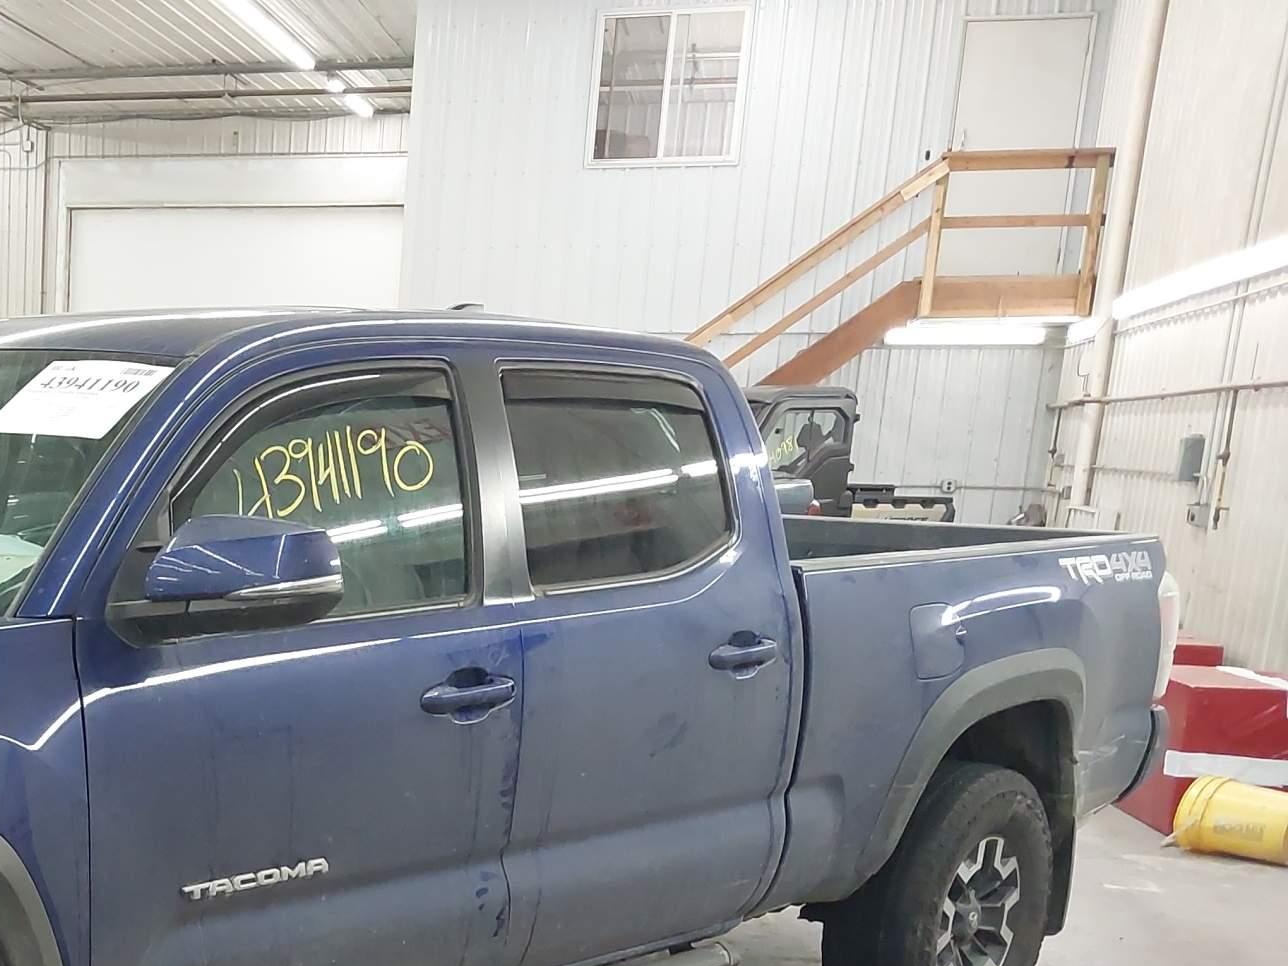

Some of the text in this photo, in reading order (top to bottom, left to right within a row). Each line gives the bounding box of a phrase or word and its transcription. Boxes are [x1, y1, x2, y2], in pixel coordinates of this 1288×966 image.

[40, 371, 141, 394] 43941190
[1058, 554, 1112, 585] TRD
[181, 857, 330, 900] TACOMA
